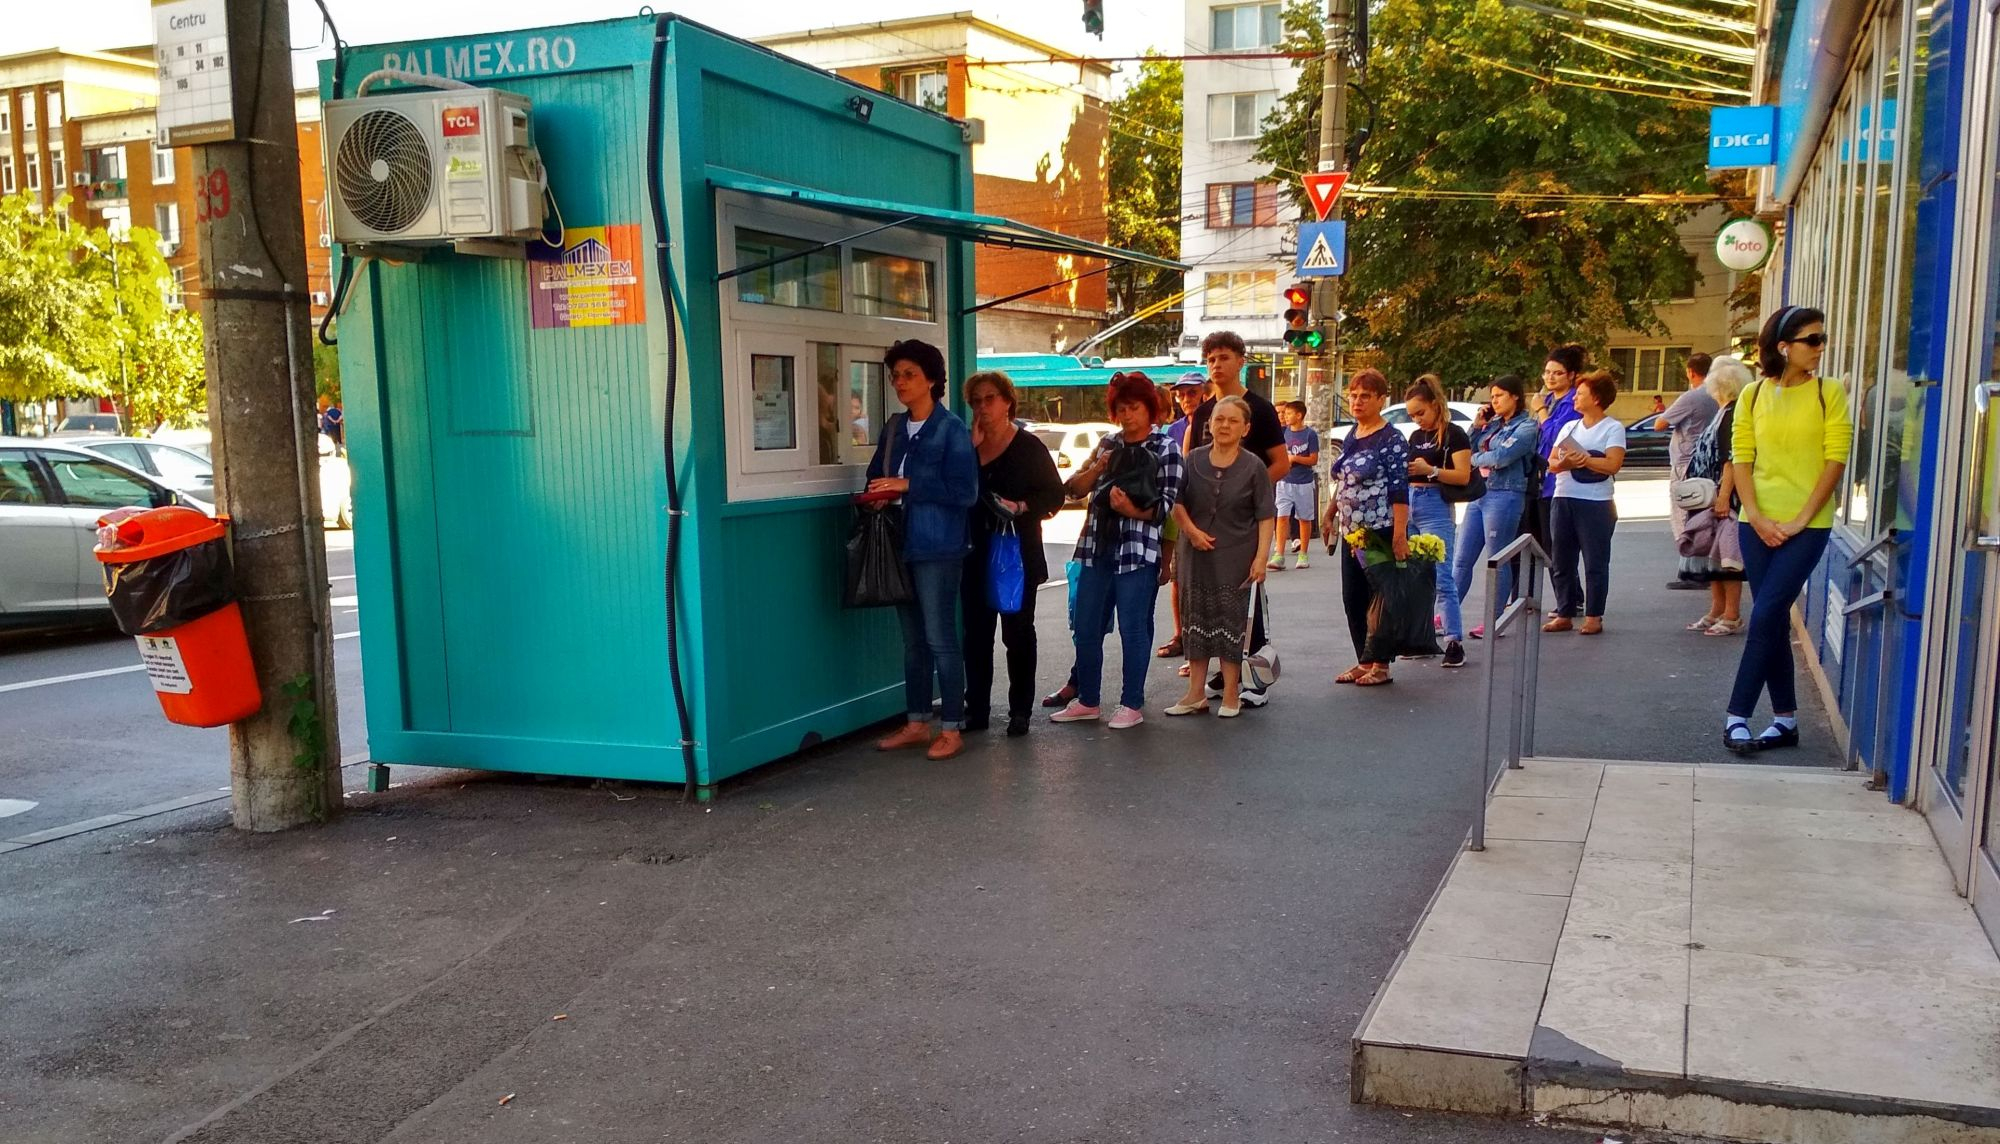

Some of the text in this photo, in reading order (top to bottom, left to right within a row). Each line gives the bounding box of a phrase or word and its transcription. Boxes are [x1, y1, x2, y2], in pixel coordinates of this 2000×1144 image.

[170, 14, 206, 30] Centru
[196, 43, 202, 54] 11
[196, 60, 204, 71] 34
[213, 56, 224, 68] 102
[383, 36, 576, 86] PALMEX.RO
[447, 116, 475, 128] TCL
[1713, 133, 1770, 148] DIGI
[1735, 240, 1761, 251] loto
[543, 263, 606, 281] PALMEX
